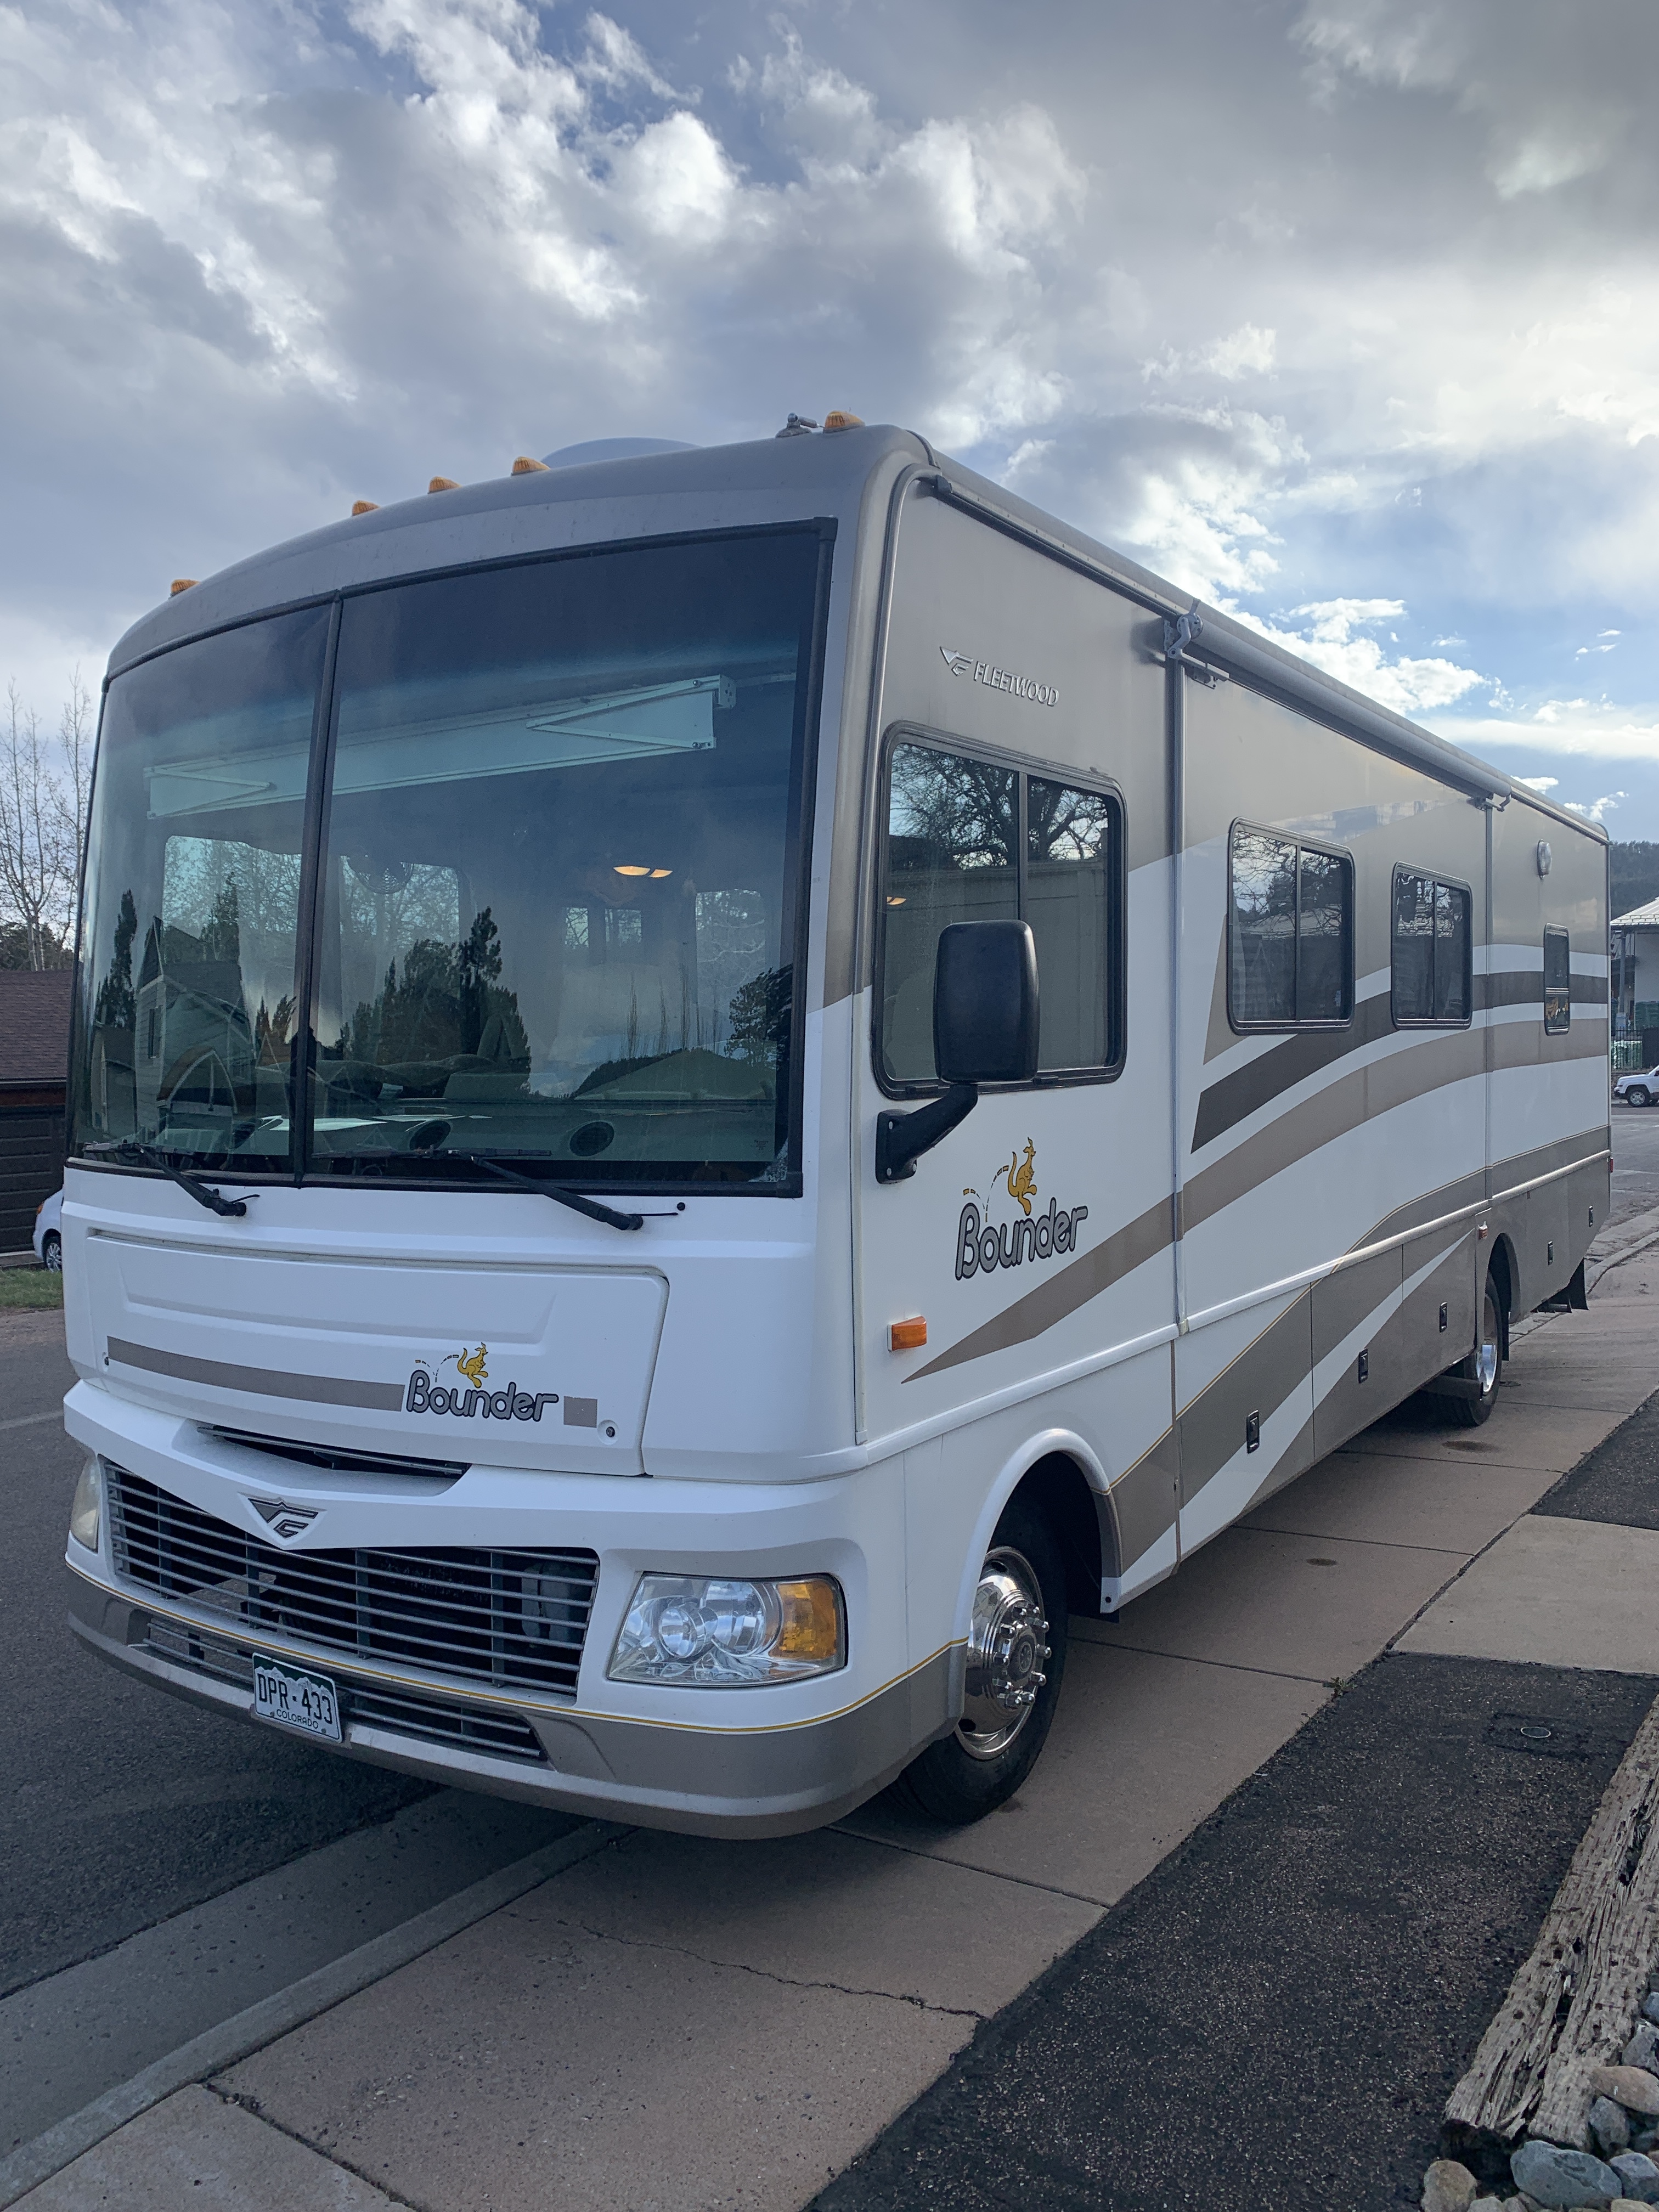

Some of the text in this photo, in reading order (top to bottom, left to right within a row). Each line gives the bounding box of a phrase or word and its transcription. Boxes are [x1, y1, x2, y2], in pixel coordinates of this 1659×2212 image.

[973, 661, 1059, 707] FLEETWOOD
[955, 1197, 1088, 1280] Bounder
[406, 1369, 559, 1422] Bounder
[276, 1709, 319, 1729] COLORADO
